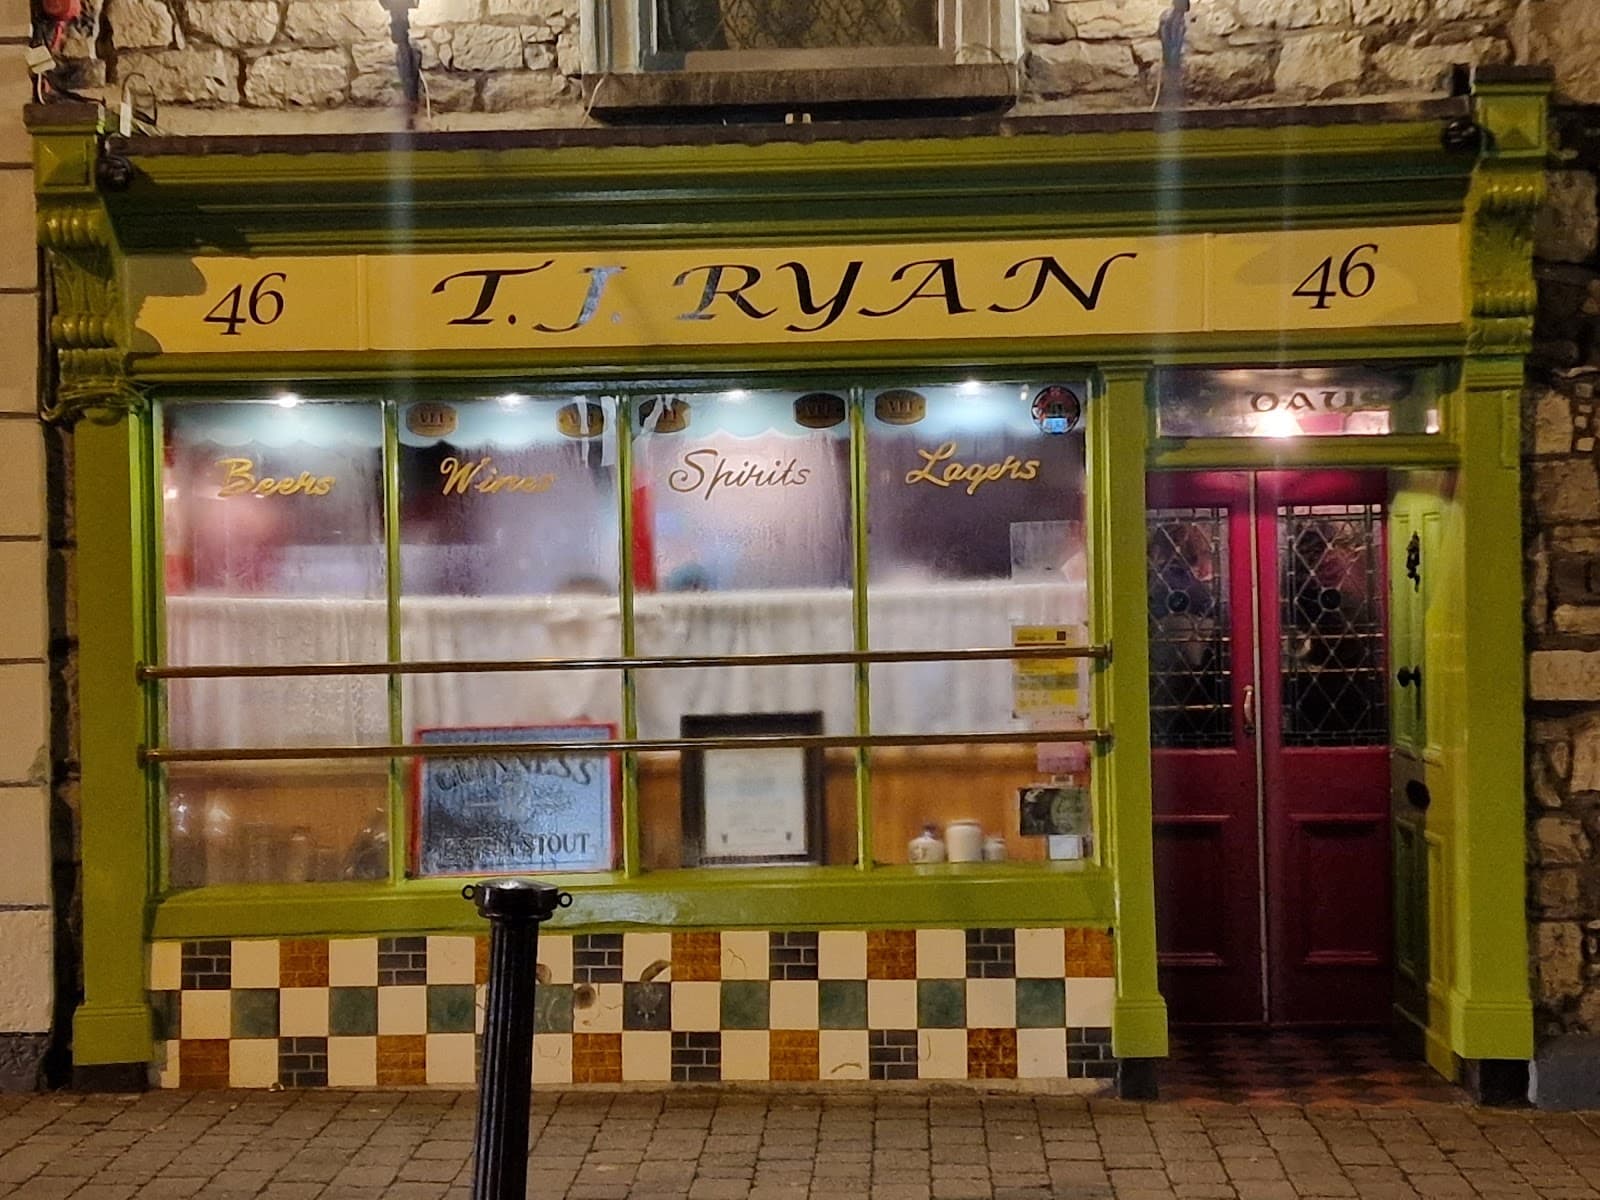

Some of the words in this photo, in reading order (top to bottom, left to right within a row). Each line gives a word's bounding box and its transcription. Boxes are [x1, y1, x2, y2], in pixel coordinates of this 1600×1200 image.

[674, 252, 1138, 333] RYAN
[1291, 243, 1378, 310] 46
[204, 272, 287, 336] 46
[215, 457, 337, 498] Beers
[439, 456, 557, 497] Wines
[668, 448, 811, 501] Spirits
[905, 440, 1041, 496] Lagers
[521, 833, 591, 857] STOUT
